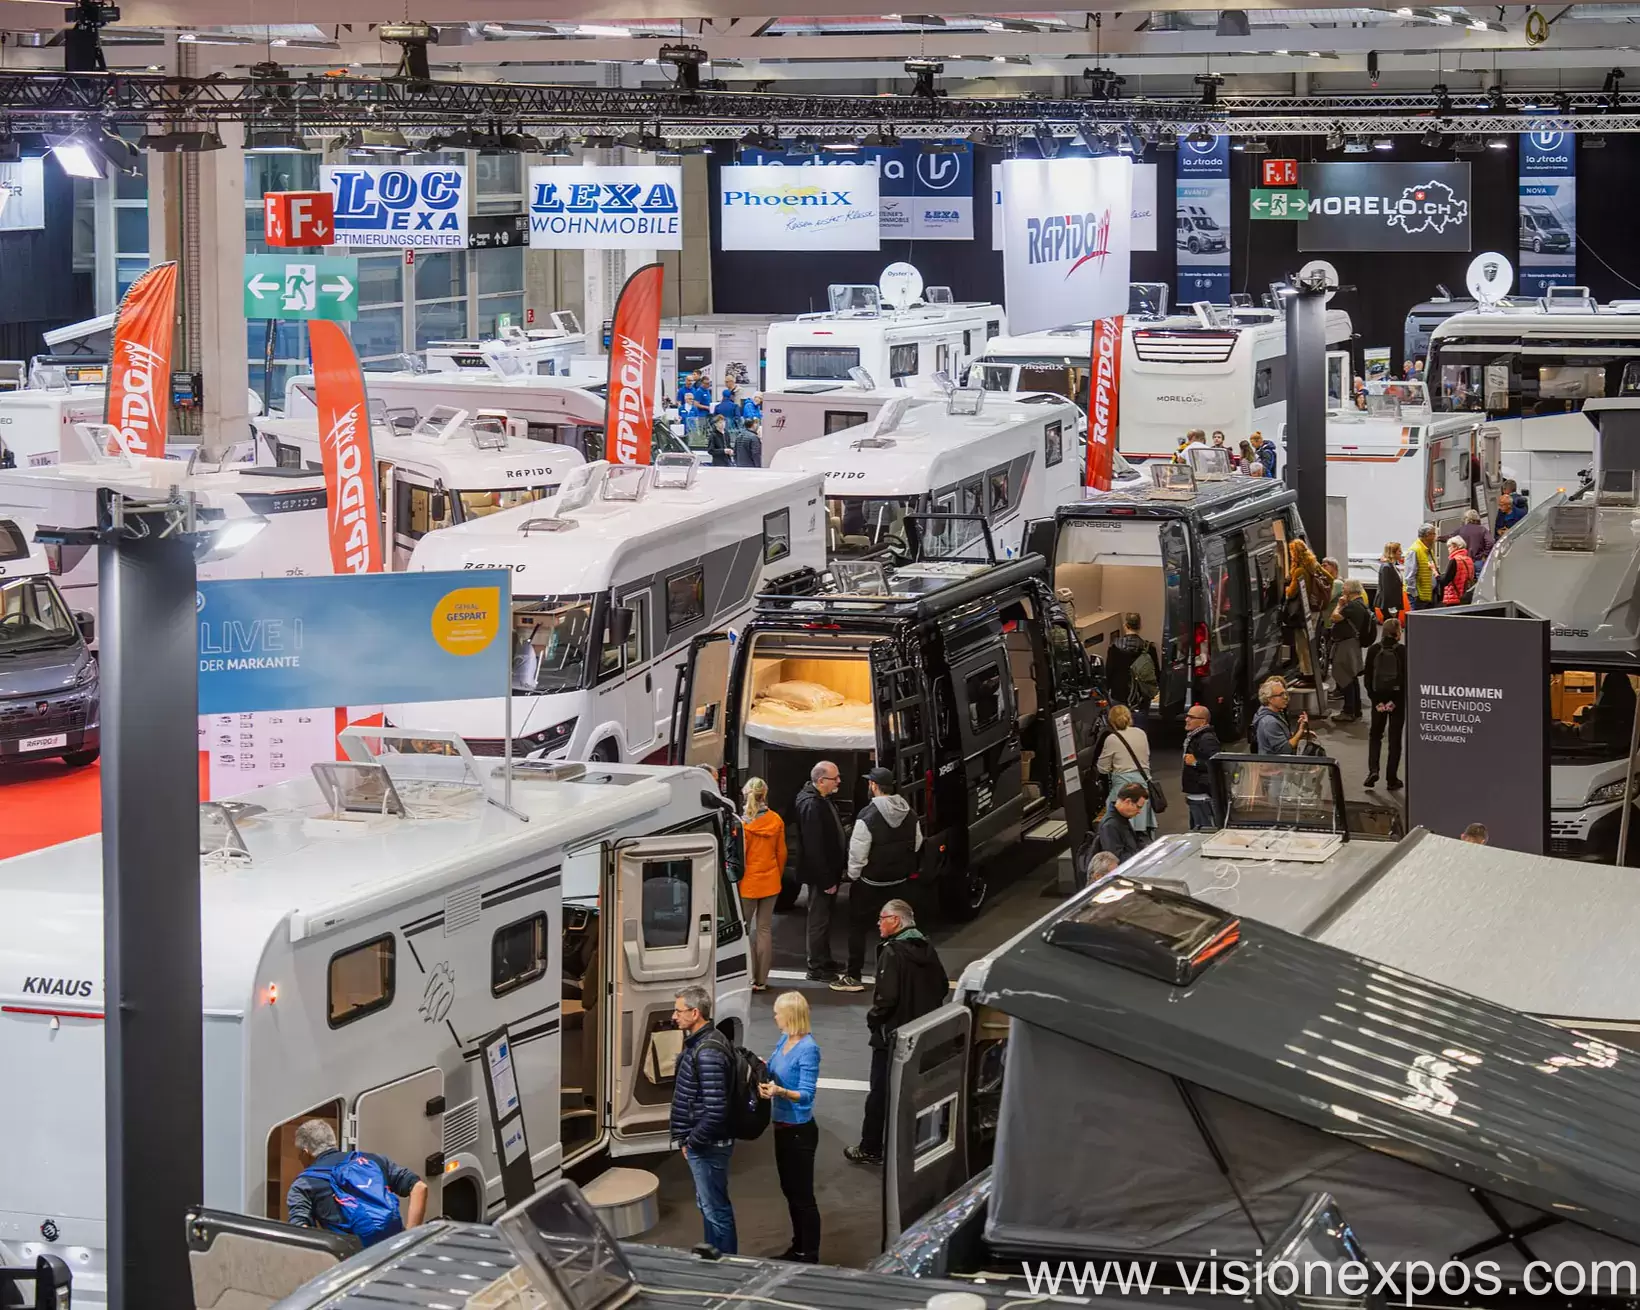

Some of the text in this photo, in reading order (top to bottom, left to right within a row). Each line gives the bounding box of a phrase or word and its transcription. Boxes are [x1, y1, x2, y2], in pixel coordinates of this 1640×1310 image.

[1266, 163, 1275, 182] F
[531, 182, 679, 214] LEXA
[266, 198, 277, 238] F
[291, 198, 312, 239] F
[530, 215, 679, 235] WOHNMOBILE
[335, 234, 462, 246] PTIMIERUNGSCENTER
[1092, 336, 1114, 445] RAPIDO
[121, 368, 151, 457] PIDO
[616, 364, 642, 465] APIDO
[505, 467, 553, 478] RAPIDO
[824, 471, 866, 479] APIDO
[273, 497, 318, 510] RAPIDO
[446, 611, 488, 621] GESPART
[200, 655, 300, 672] DER MARKANTE
[1420, 684, 1503, 699] WILLKOMMEN
[1420, 698, 1492, 712] BIENVENIDOS
[1420, 711, 1481, 724] TERVETULOA
[1420, 723, 1473, 734] VELKOMMEN
[22, 976, 93, 997] KNAUS
